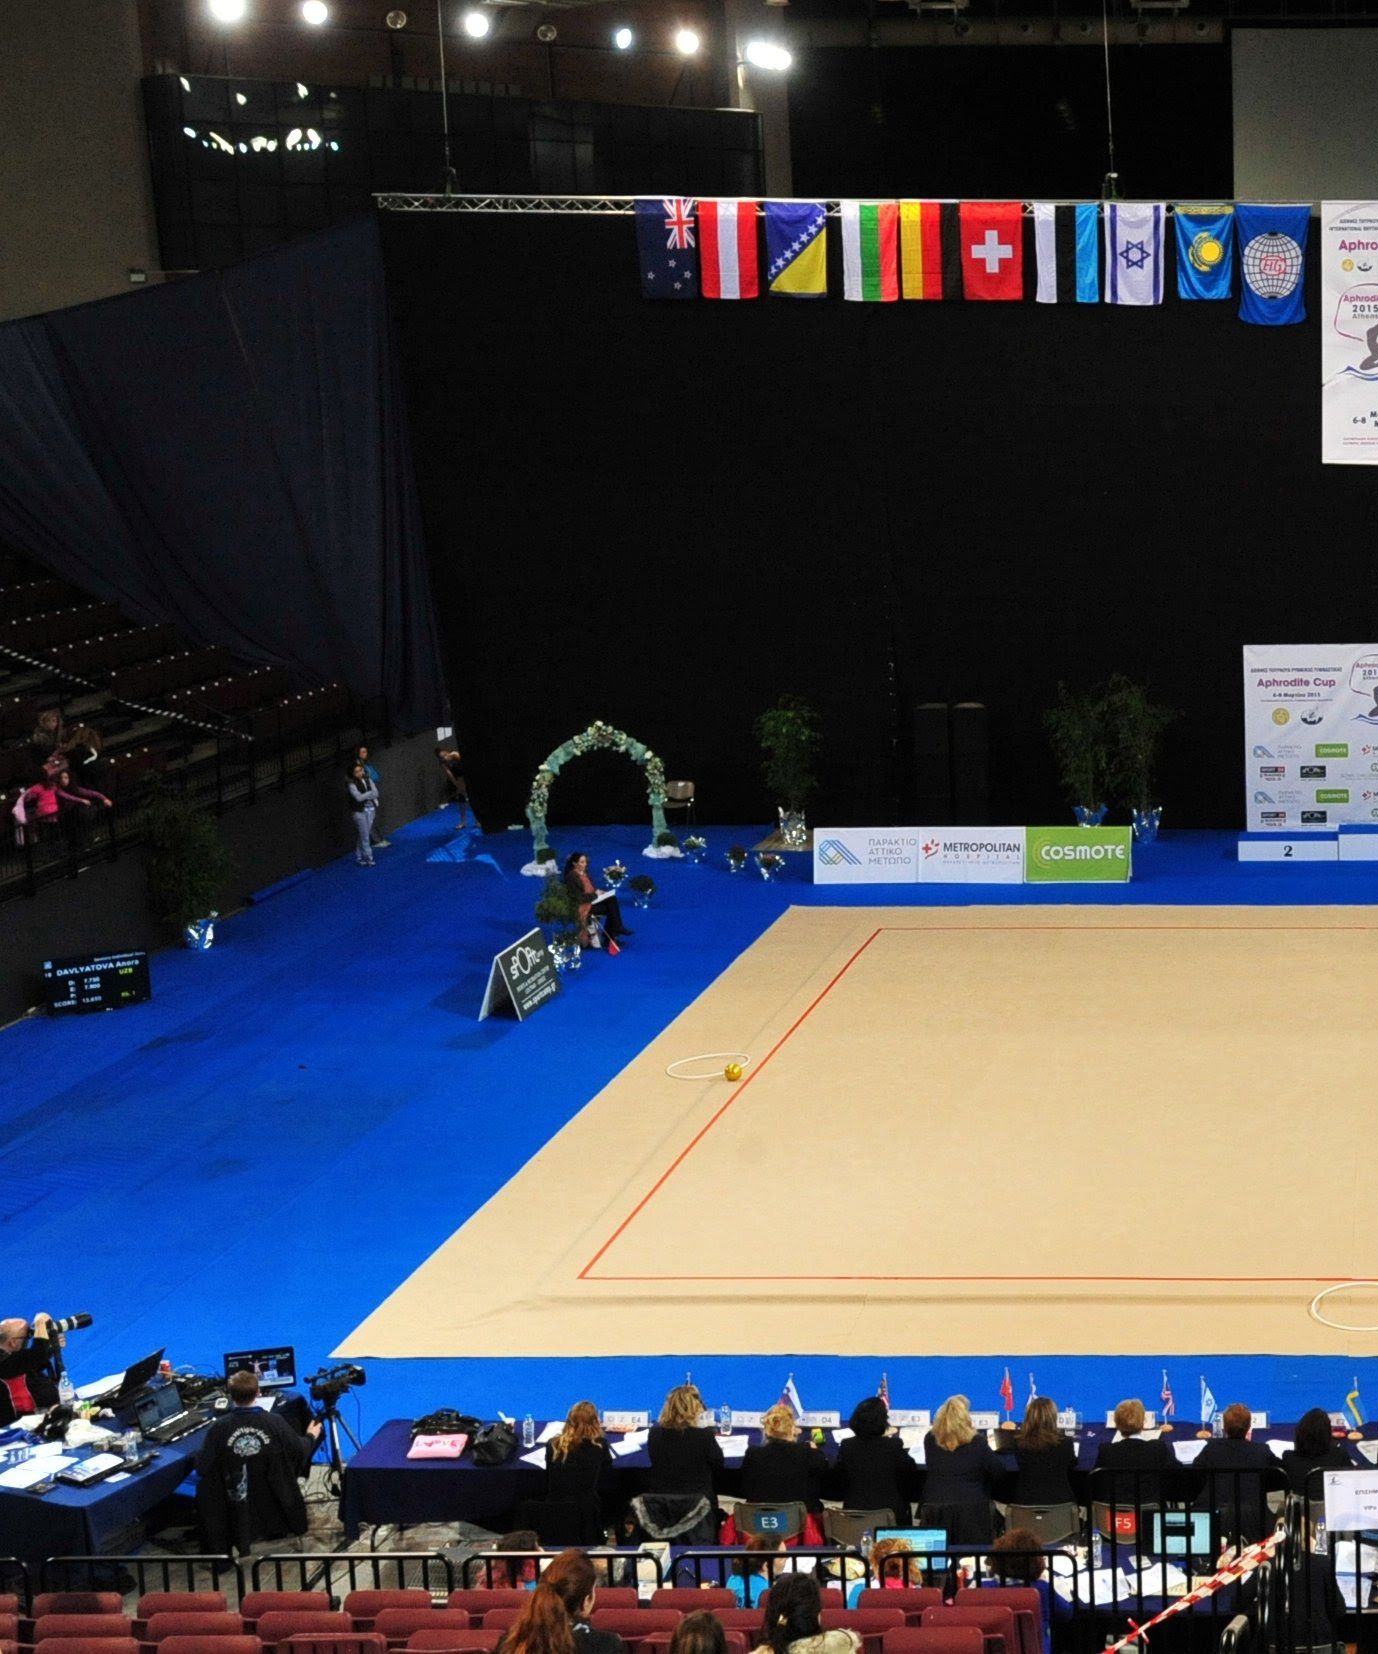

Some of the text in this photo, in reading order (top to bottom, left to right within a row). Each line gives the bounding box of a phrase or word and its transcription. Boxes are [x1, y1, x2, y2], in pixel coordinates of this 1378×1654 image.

[1352, 304, 1378, 313] 2015
[1257, 678, 1336, 688] Aphrodite Cup
[868, 838, 917, 846] ΠΑΡΑΚΤΙΟ
[943, 842, 1021, 852] METROPOLITAN
[868, 847, 902, 855] ΑΤΤΙΚΟ
[1041, 845, 1125, 860] COSMOTE
[1283, 845, 1293, 857] 2
[868, 856, 912, 865] ΜΕΤΩΠΟ
[56, 963, 114, 977] DAVLYATOVA
[116, 959, 139, 968] Anora
[761, 1516, 779, 1529] E3
[1115, 1517, 1131, 1529] F5
